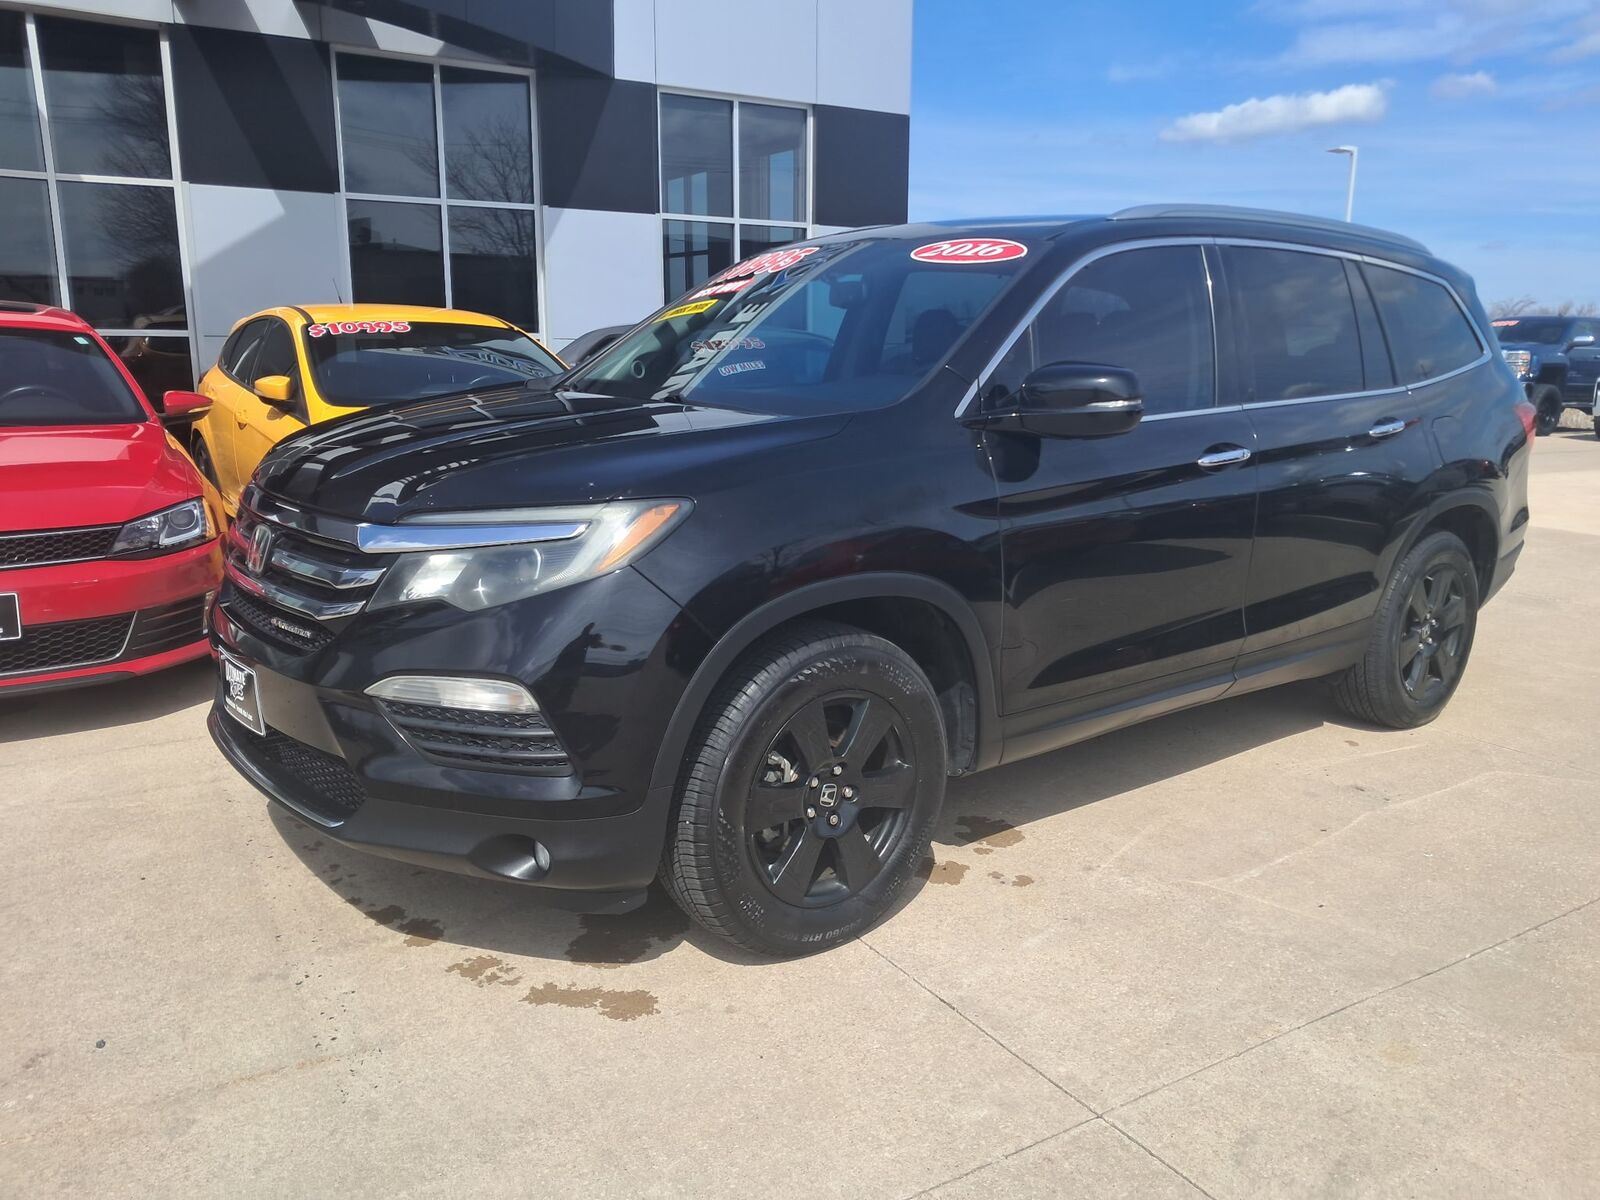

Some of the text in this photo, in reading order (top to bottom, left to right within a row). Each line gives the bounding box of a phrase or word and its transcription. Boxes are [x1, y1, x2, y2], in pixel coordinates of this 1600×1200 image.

[916, 243, 1015, 257] 2016
[308, 321, 411, 338] $10995
[718, 363, 738, 376] LOW
